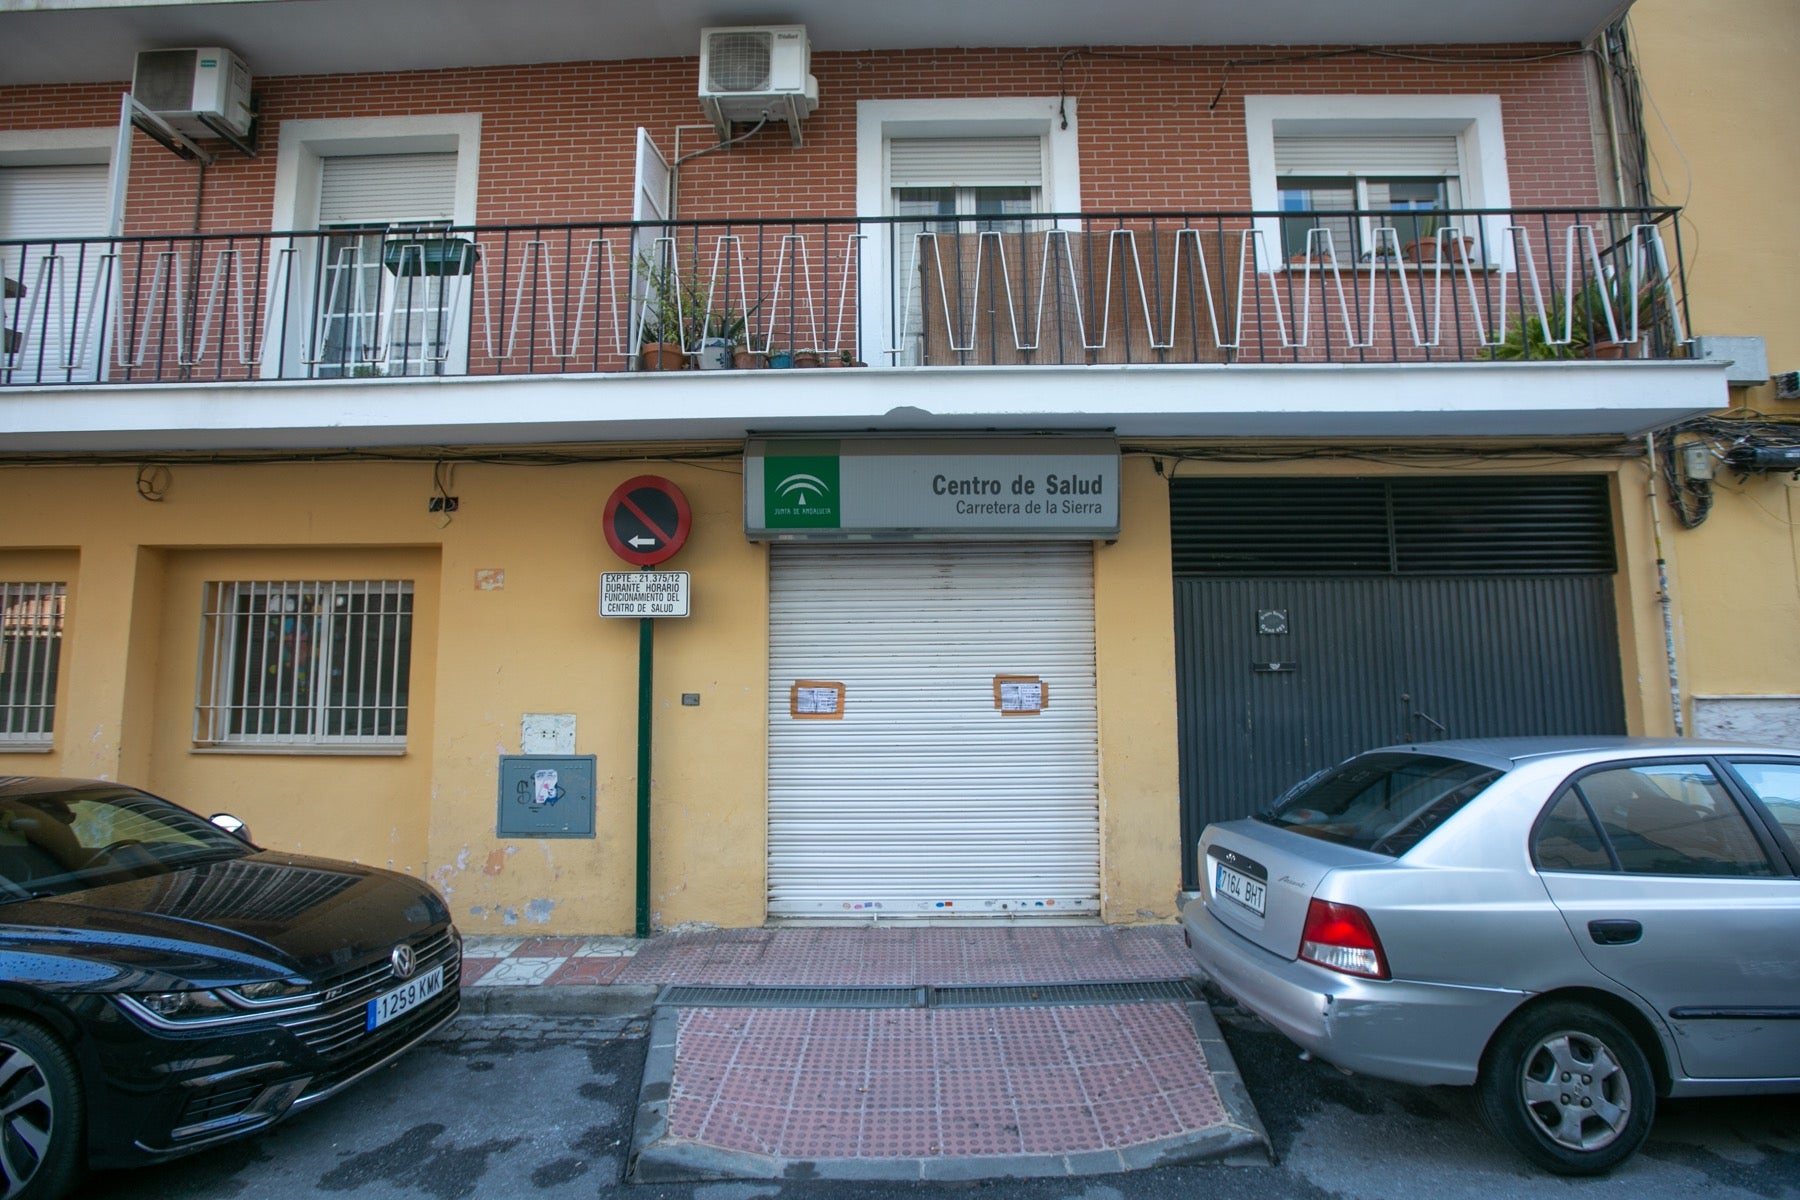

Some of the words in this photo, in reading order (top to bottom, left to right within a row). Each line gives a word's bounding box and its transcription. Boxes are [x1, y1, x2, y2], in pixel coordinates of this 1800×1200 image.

[933, 474, 1001, 496] Centro
[1011, 474, 1035, 496] de
[1046, 474, 1103, 496] Salud
[793, 507, 800, 515] DE
[956, 500, 1021, 515] Carretera
[1025, 500, 1042, 515] de
[1046, 500, 1059, 515] la
[1062, 500, 1103, 515] Sierra
[606, 583, 640, 592] DURANTE
[646, 583, 679, 592] HORARIO
[605, 593, 663, 601] FUNCIONAMIENTO
[667, 593, 680, 602] DEL
[608, 604, 634, 612] CENTRO
[638, 604, 646, 612] DE
[651, 604, 673, 612] SALUD
[1222, 871, 1241, 896] 7164
[1245, 882, 1263, 908] BHT
[382, 984, 416, 1019] 1259
[419, 970, 441, 999] KMK
